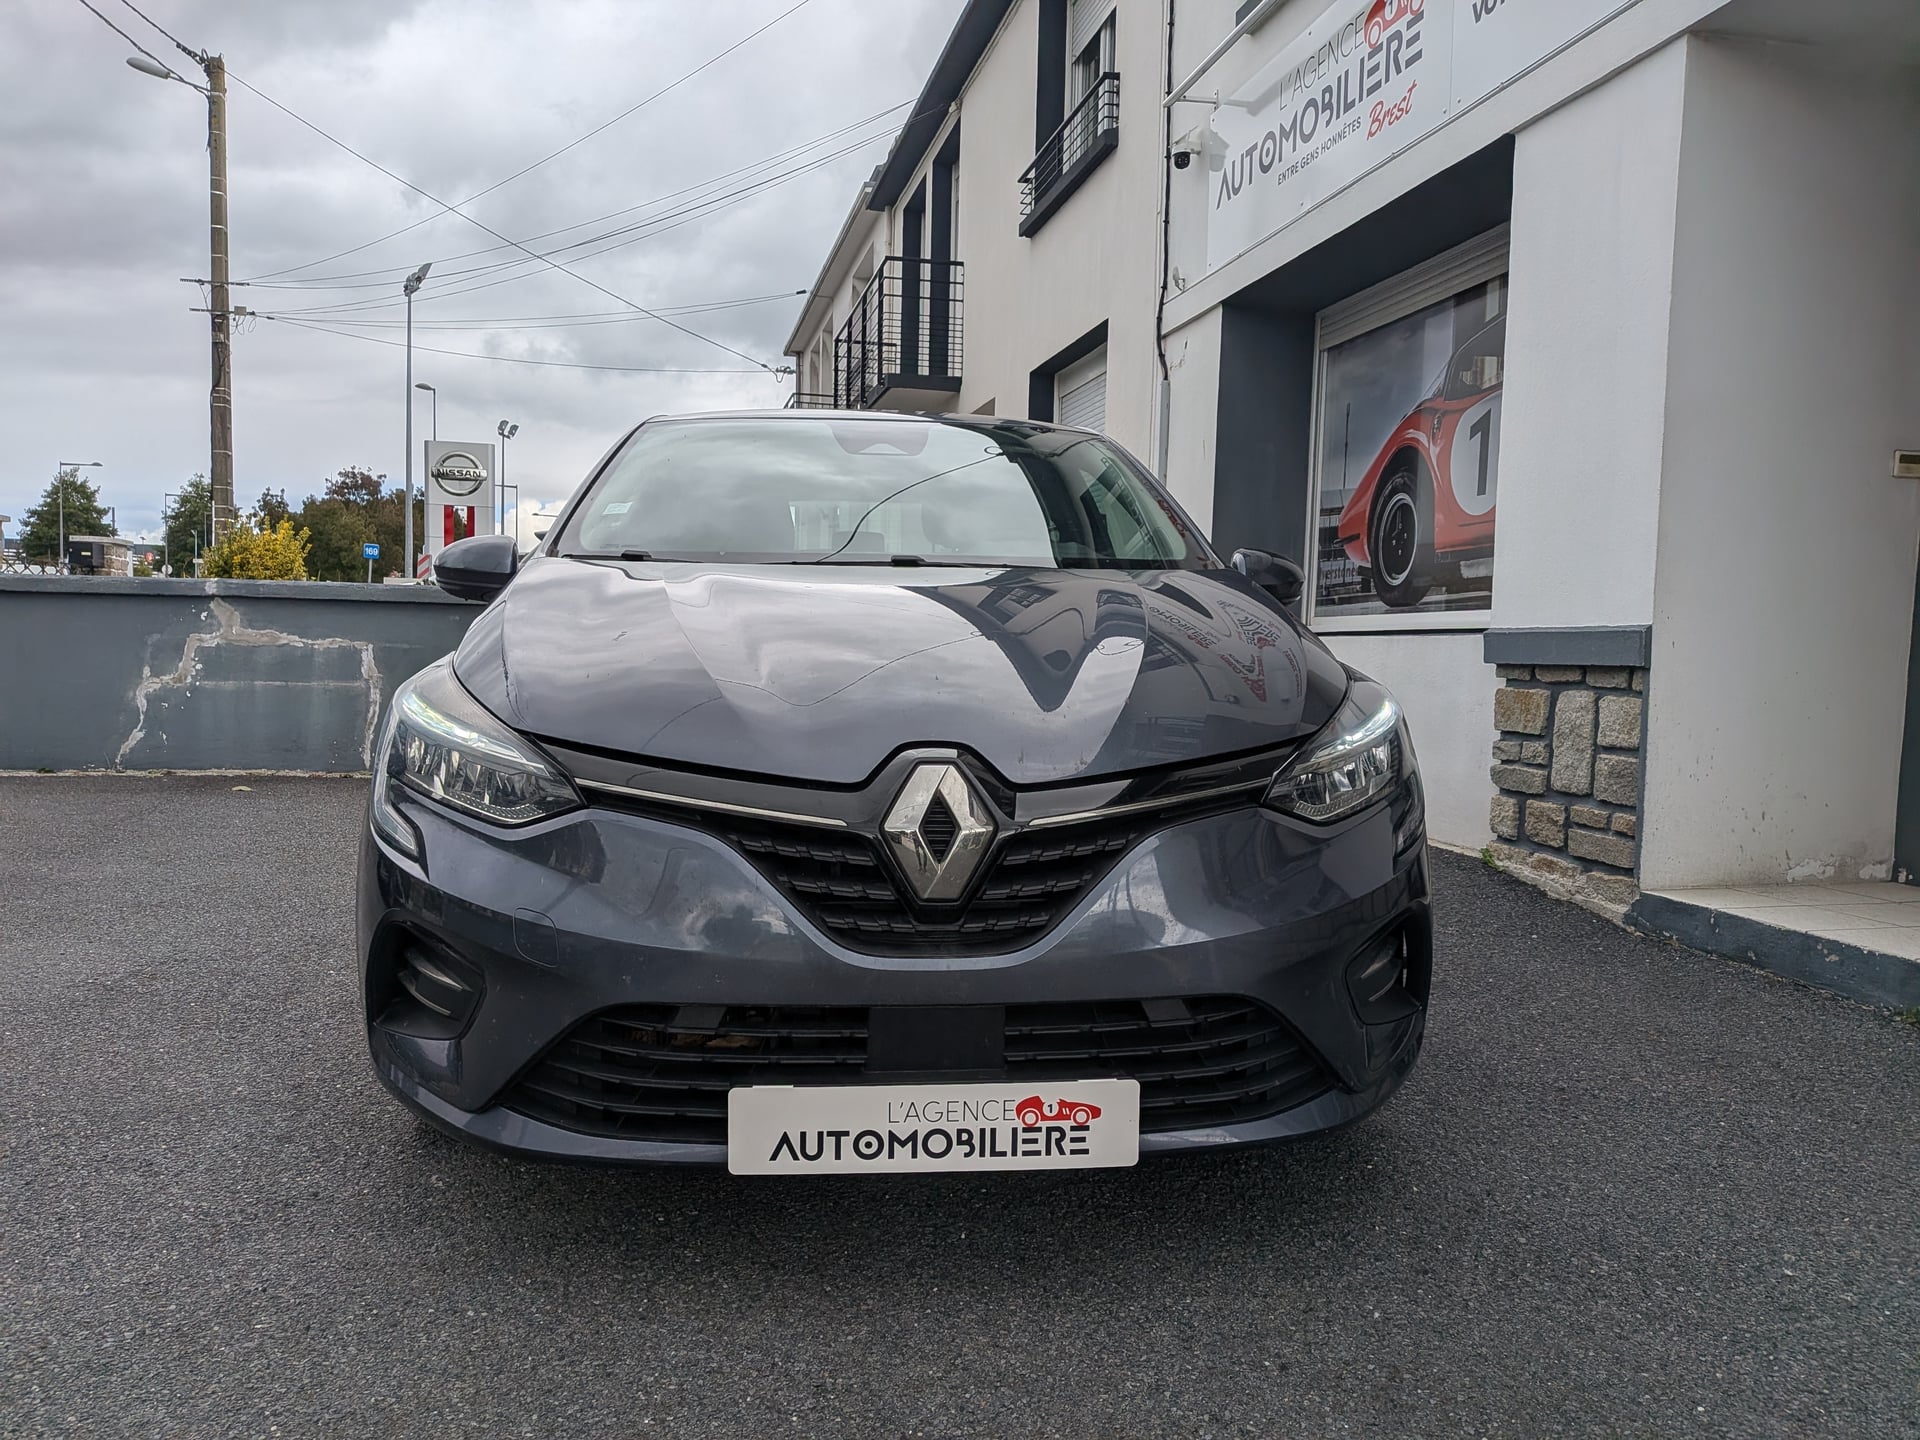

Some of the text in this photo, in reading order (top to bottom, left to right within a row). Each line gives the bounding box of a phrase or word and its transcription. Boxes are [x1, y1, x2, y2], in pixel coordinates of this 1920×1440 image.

[1472, 0, 1505, 24] VO
[1279, 11, 1366, 111] L'AGENCE
[1277, 116, 1362, 186] ENTRE GENS HONNÊTES
[1469, 407, 1492, 497] 1
[436, 468, 482, 479] NISSAN
[888, 1098, 1016, 1124] L'AGENCE
[1047, 1103, 1053, 1114] 1
